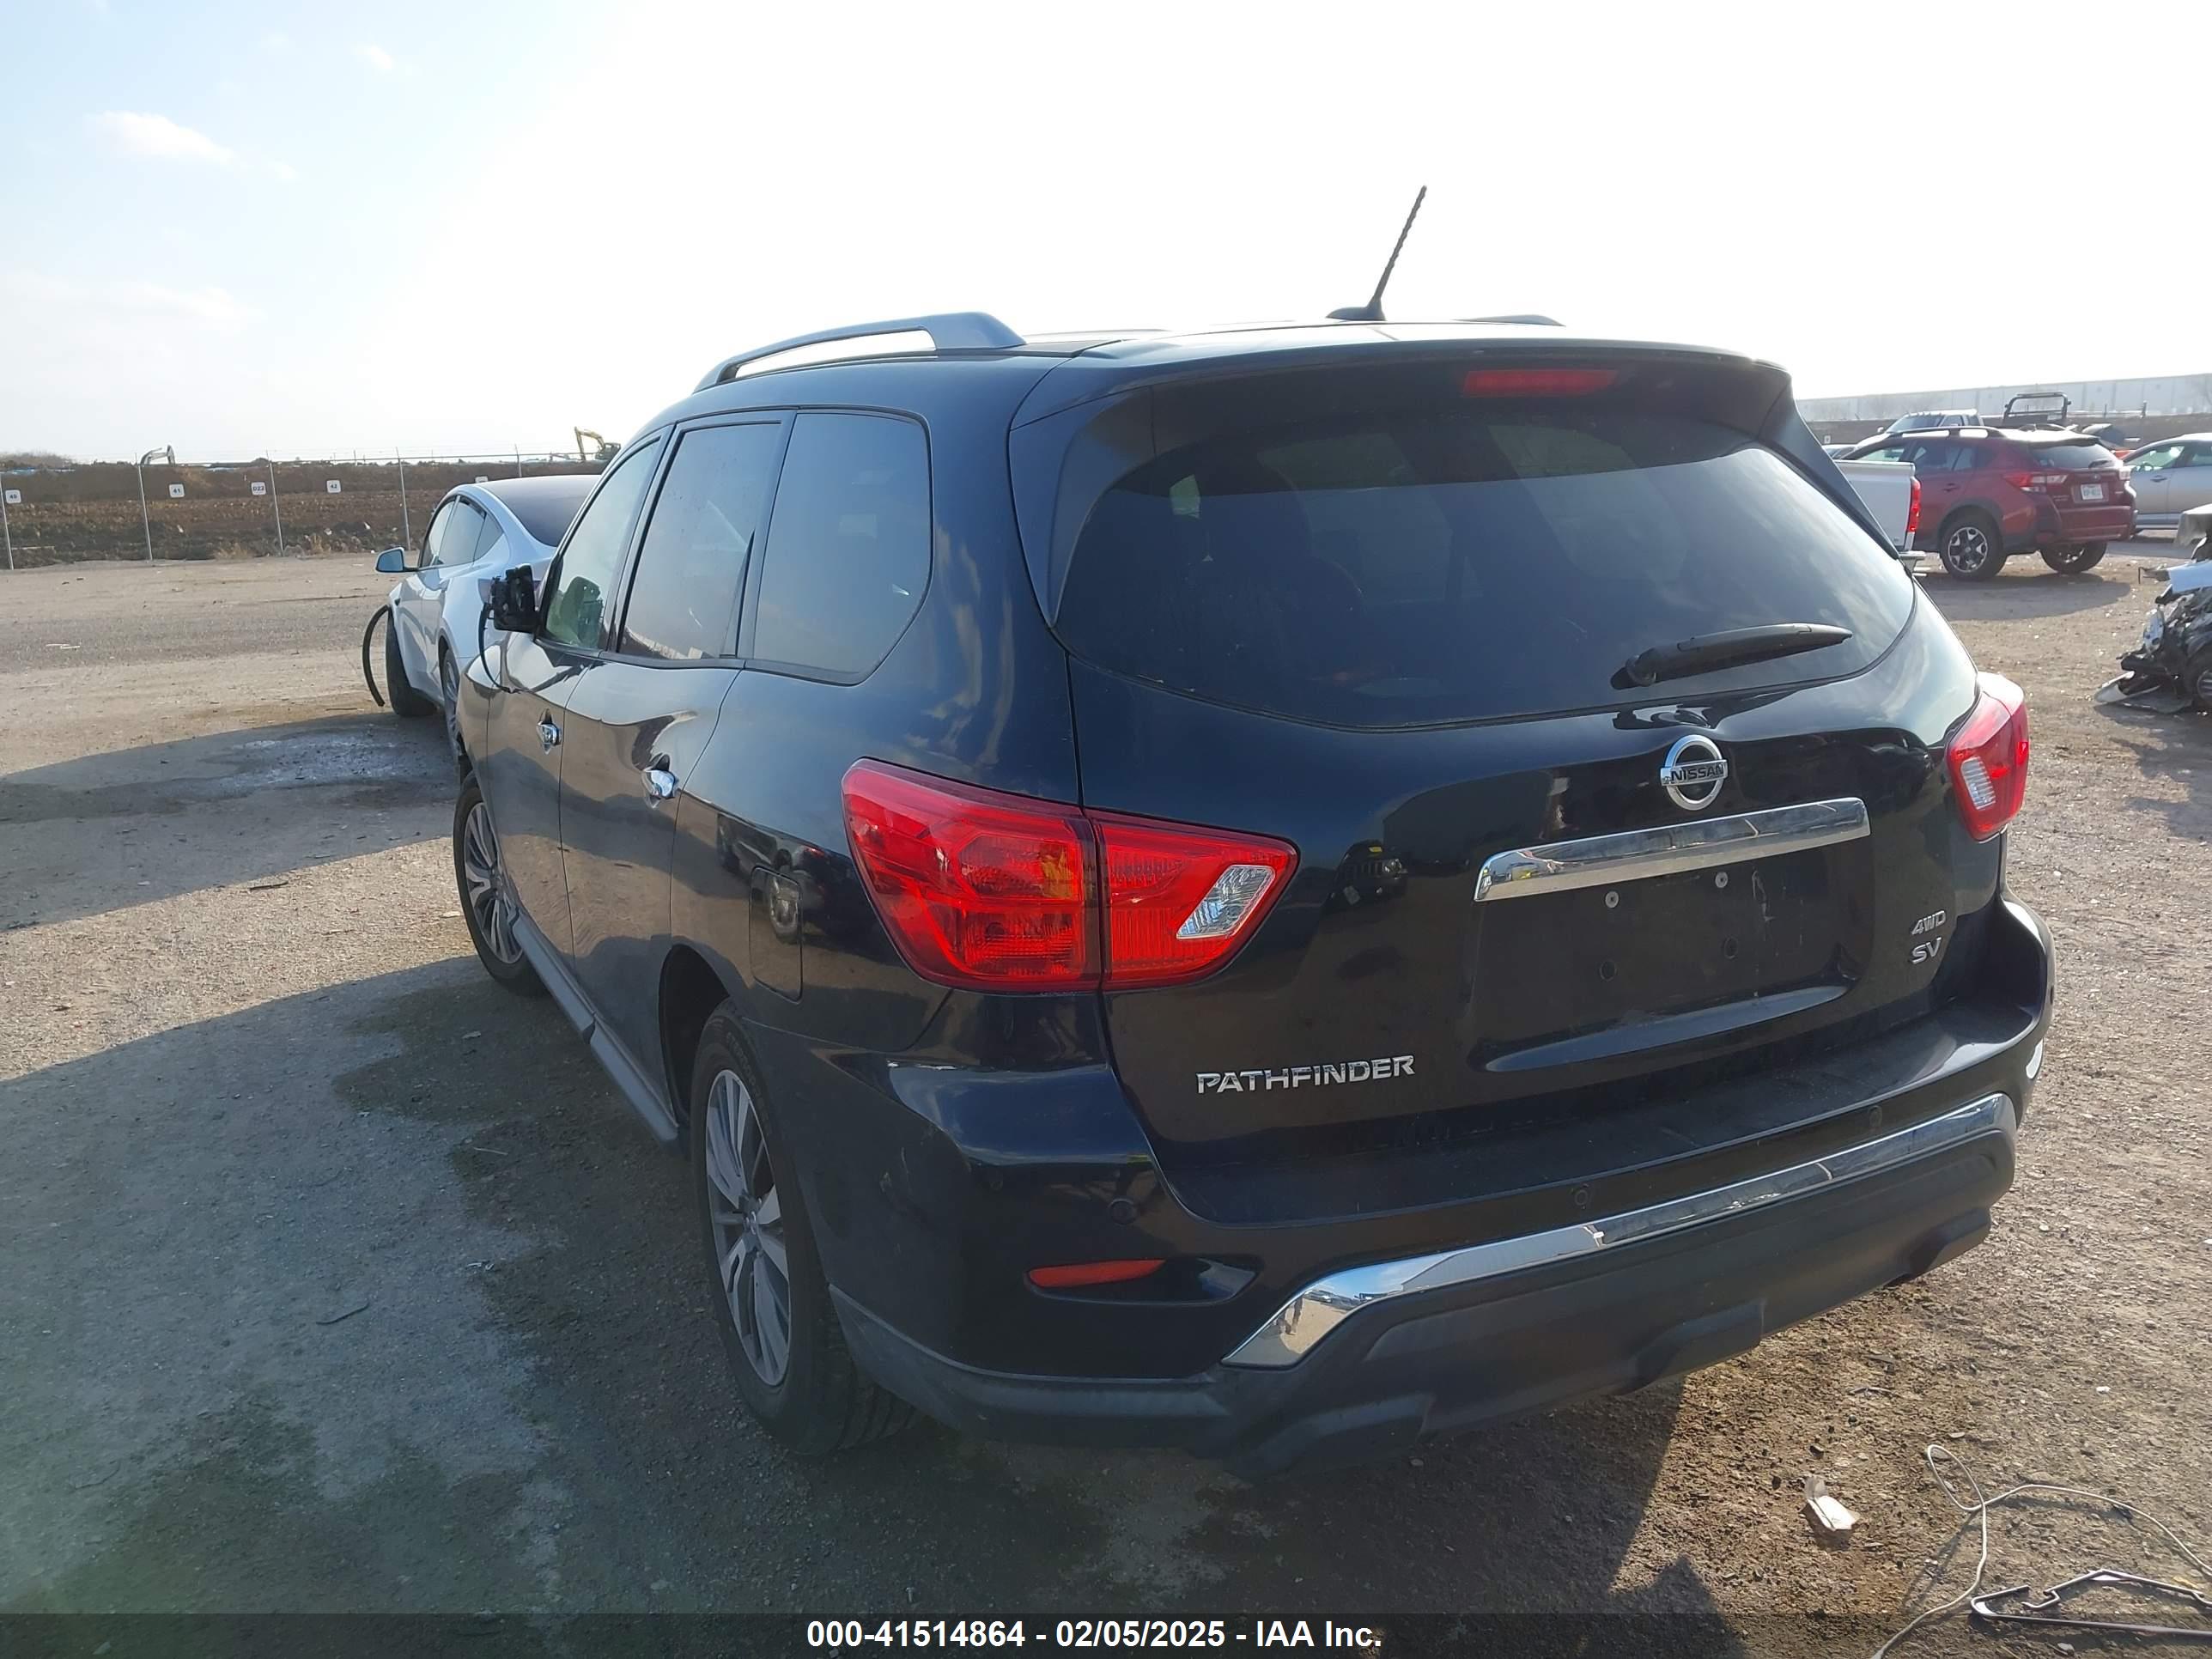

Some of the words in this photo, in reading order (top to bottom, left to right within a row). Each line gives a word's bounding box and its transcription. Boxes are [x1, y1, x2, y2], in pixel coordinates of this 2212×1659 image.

[1670, 763, 1724, 783] NISSAN
[1911, 909, 1947, 935] 4WD
[1911, 936, 1942, 964] SV
[1195, 1054, 1416, 1094] PATHFINDER
